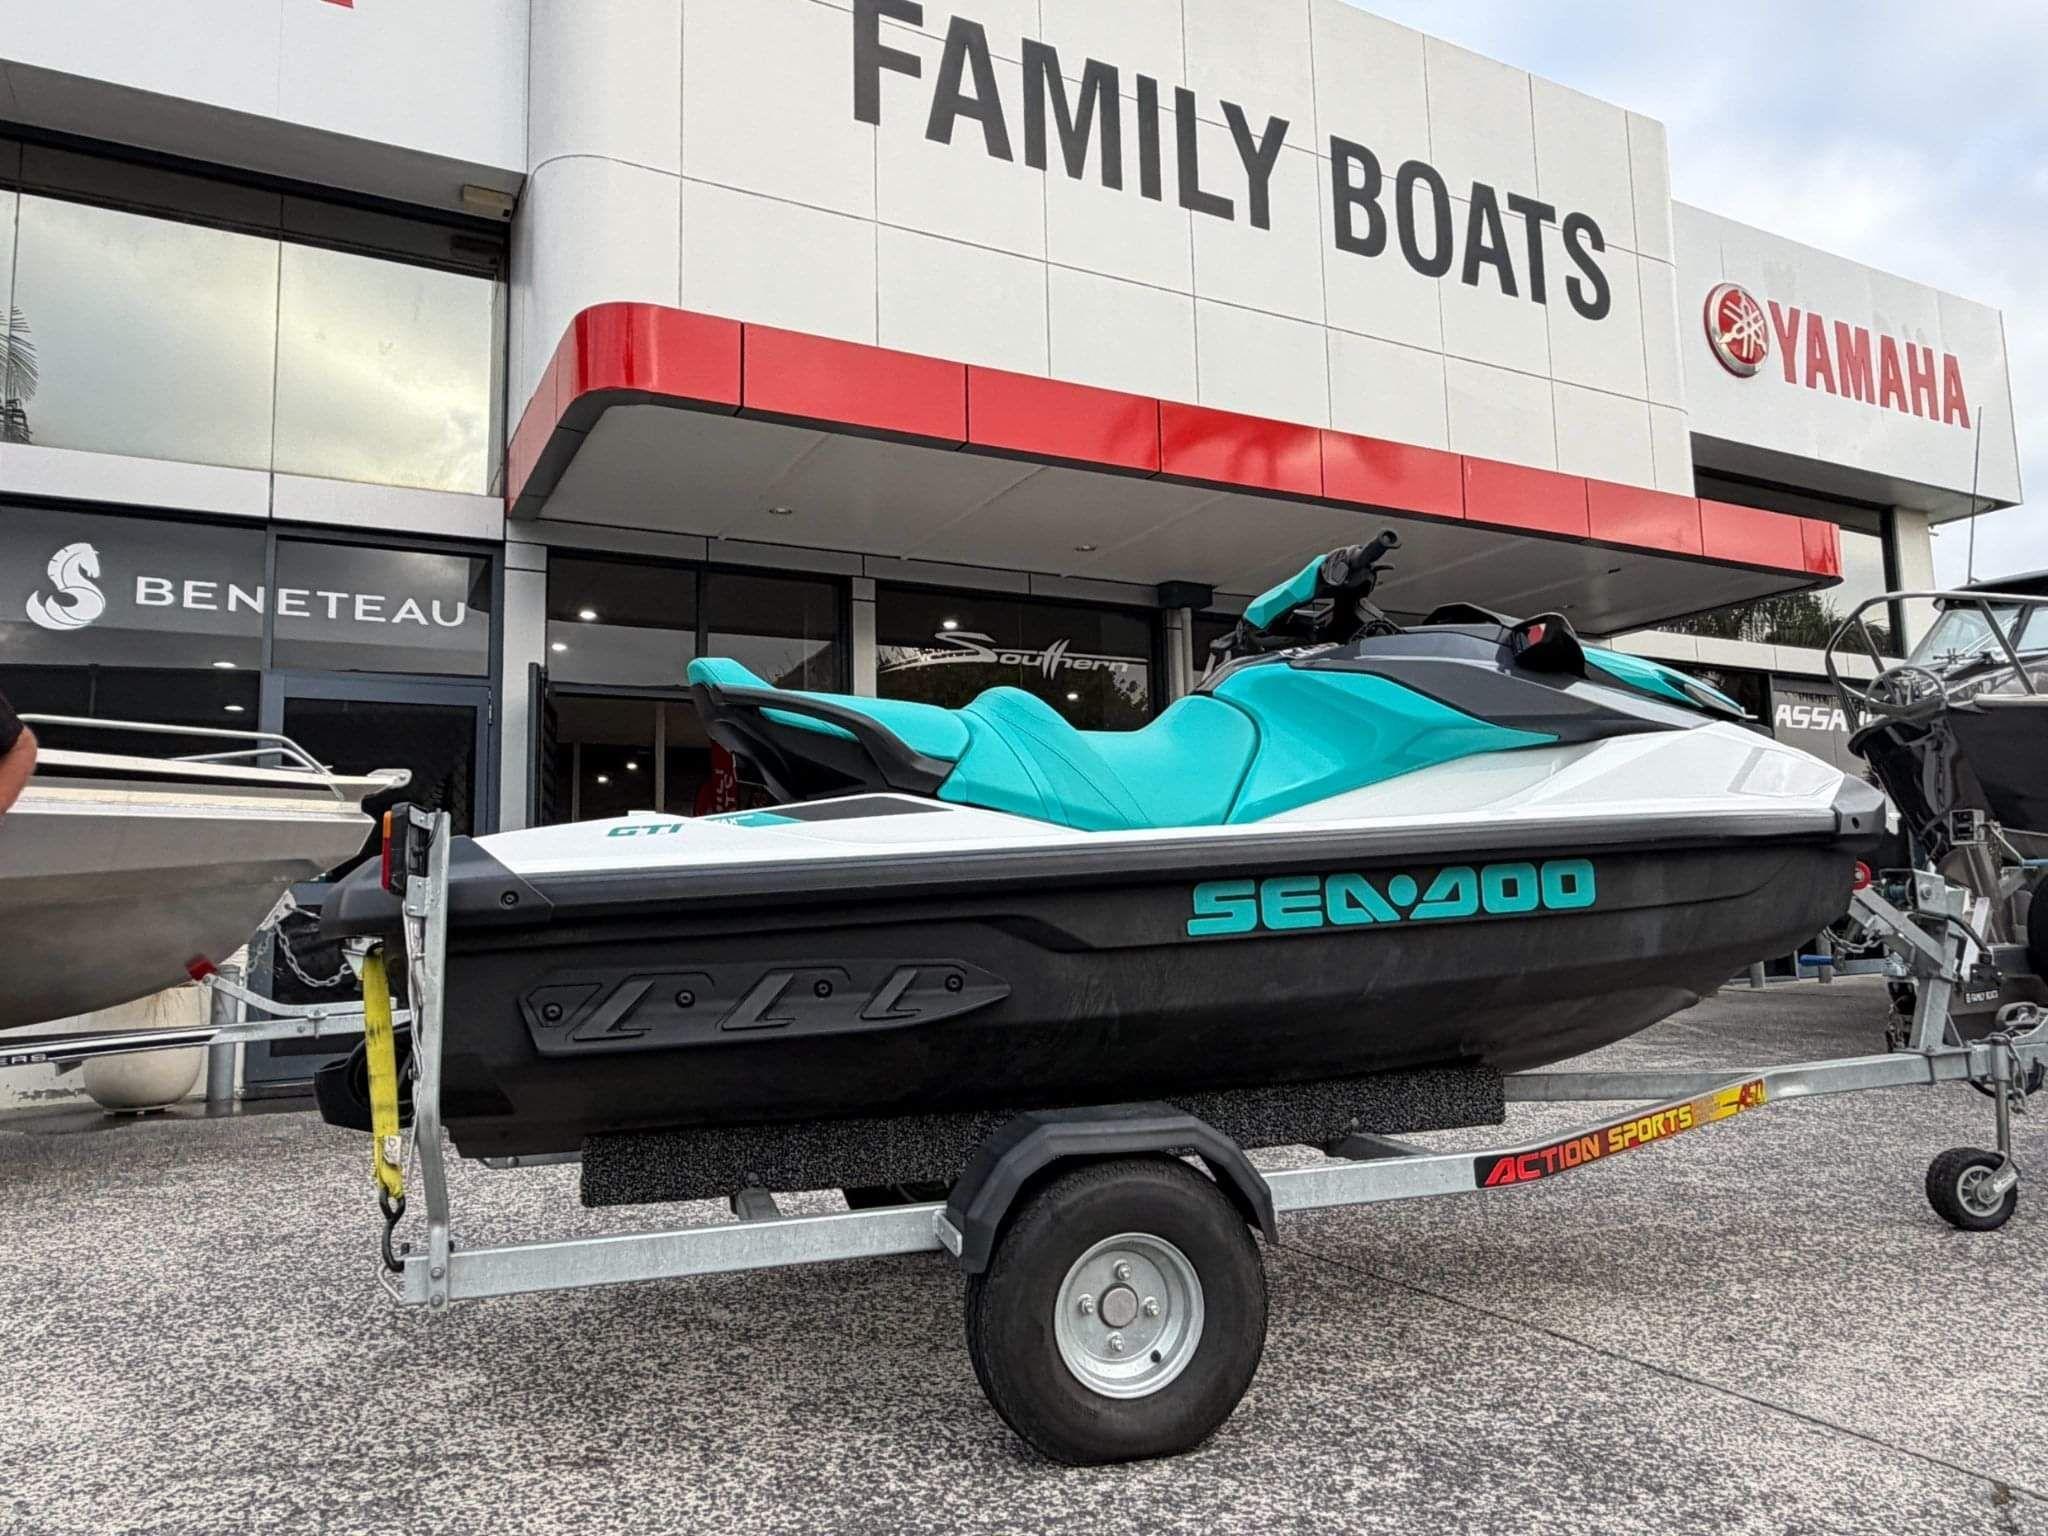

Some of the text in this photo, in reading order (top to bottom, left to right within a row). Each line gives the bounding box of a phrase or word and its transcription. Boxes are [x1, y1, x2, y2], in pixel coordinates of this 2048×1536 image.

[854, 0, 1612, 322] FAMILY BOATS
[1767, 299, 1971, 430] YAMAHA
[135, 575, 466, 628] BENETEAU
[880, 630, 1128, 681] Southern
[1775, 703, 1888, 732] ASSA
[607, 822, 685, 837] GTI
[1484, 1103, 1694, 1186] ACTION SPORTS
